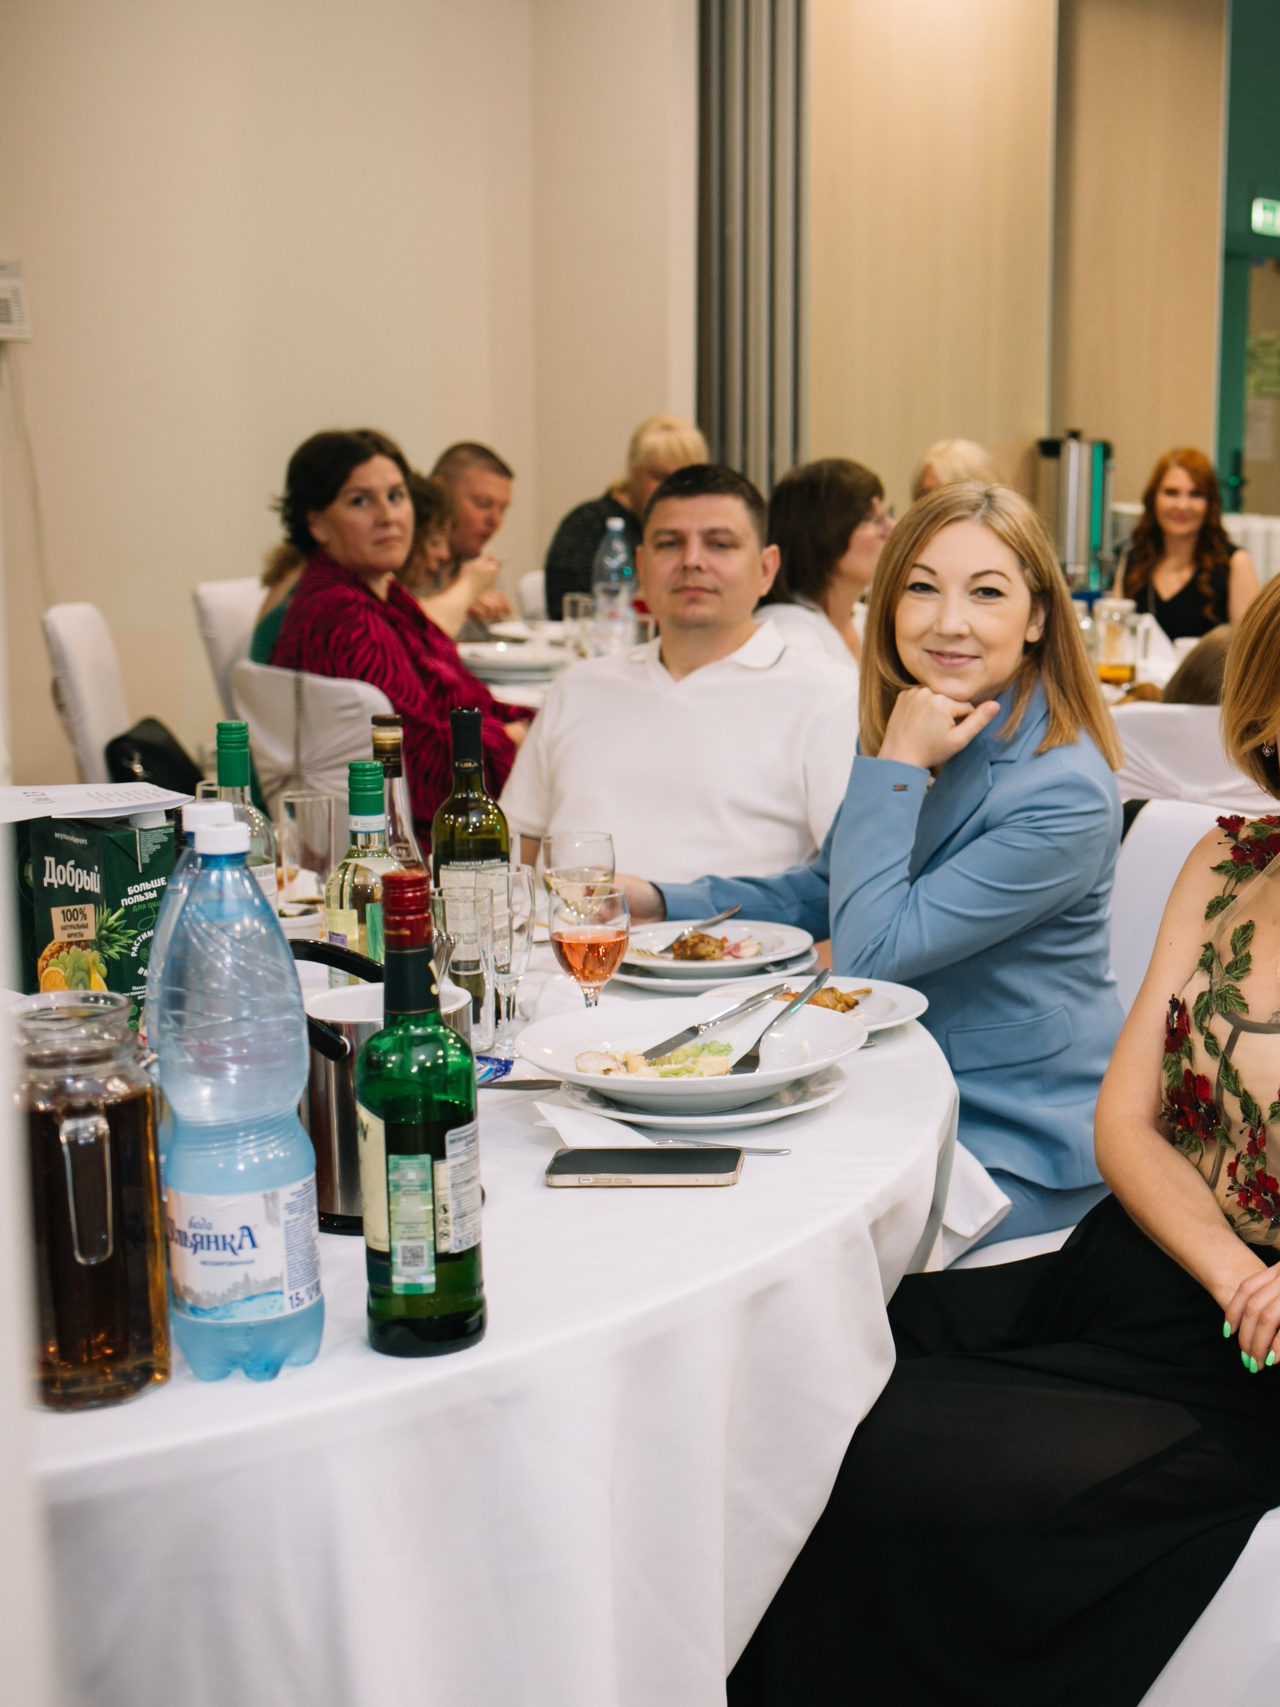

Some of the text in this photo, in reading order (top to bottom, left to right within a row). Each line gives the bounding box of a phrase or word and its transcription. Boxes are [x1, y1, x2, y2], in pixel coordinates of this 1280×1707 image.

[43, 855, 101, 894] Добрый
[127, 876, 168, 896] БОЛЬШЕ
[120, 889, 158, 907] ПОЛЬЗЫ
[61, 906, 88, 922] 100%
[130, 929, 155, 958] РАСТИМ
